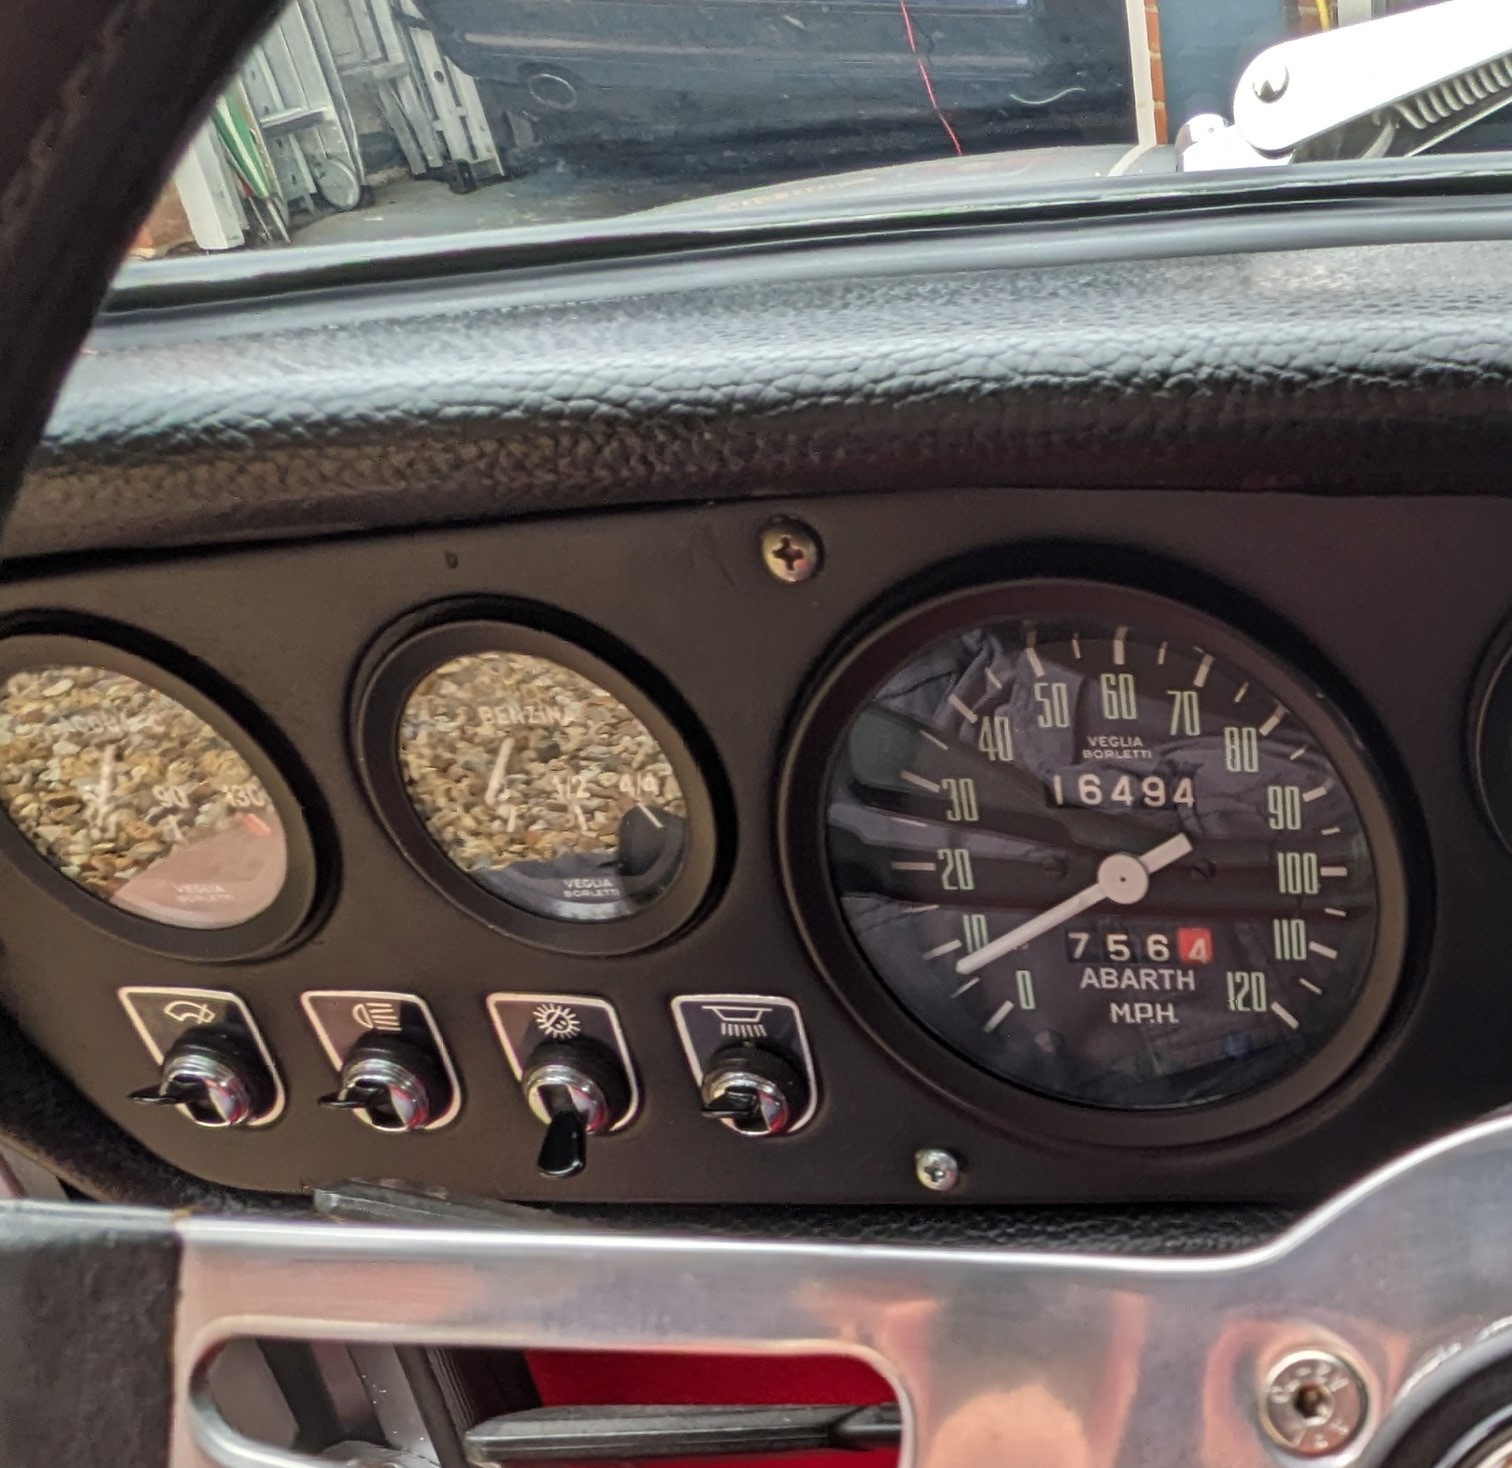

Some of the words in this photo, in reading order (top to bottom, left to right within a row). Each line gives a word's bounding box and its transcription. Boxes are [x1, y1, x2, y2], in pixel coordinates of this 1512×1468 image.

[1034, 683, 1070, 728] 50
[1100, 674, 1137, 719] 60
[1168, 691, 1200, 735] 70
[978, 717, 1014, 761] 40
[1082, 749, 1152, 759] BORLETTI
[1087, 736, 1143, 748] VEGLIA
[1224, 728, 1259, 772] 80
[153, 784, 189, 808] 90
[942, 778, 979, 822] 30
[1053, 774, 1195, 808] 16494
[1268, 786, 1301, 830] 90
[562, 879, 612, 889] VEGLIA
[938, 849, 974, 890] 20
[1277, 853, 1319, 894] 100
[562, 889, 620, 899] BORLETTI
[963, 914, 988, 953] 10
[1273, 919, 1307, 960] 110
[1016, 970, 1036, 1010] 0
[1080, 967, 1196, 990] ABARTH
[1226, 972, 1266, 1012] 120
[1110, 1002, 1179, 1024] M.P.H.
